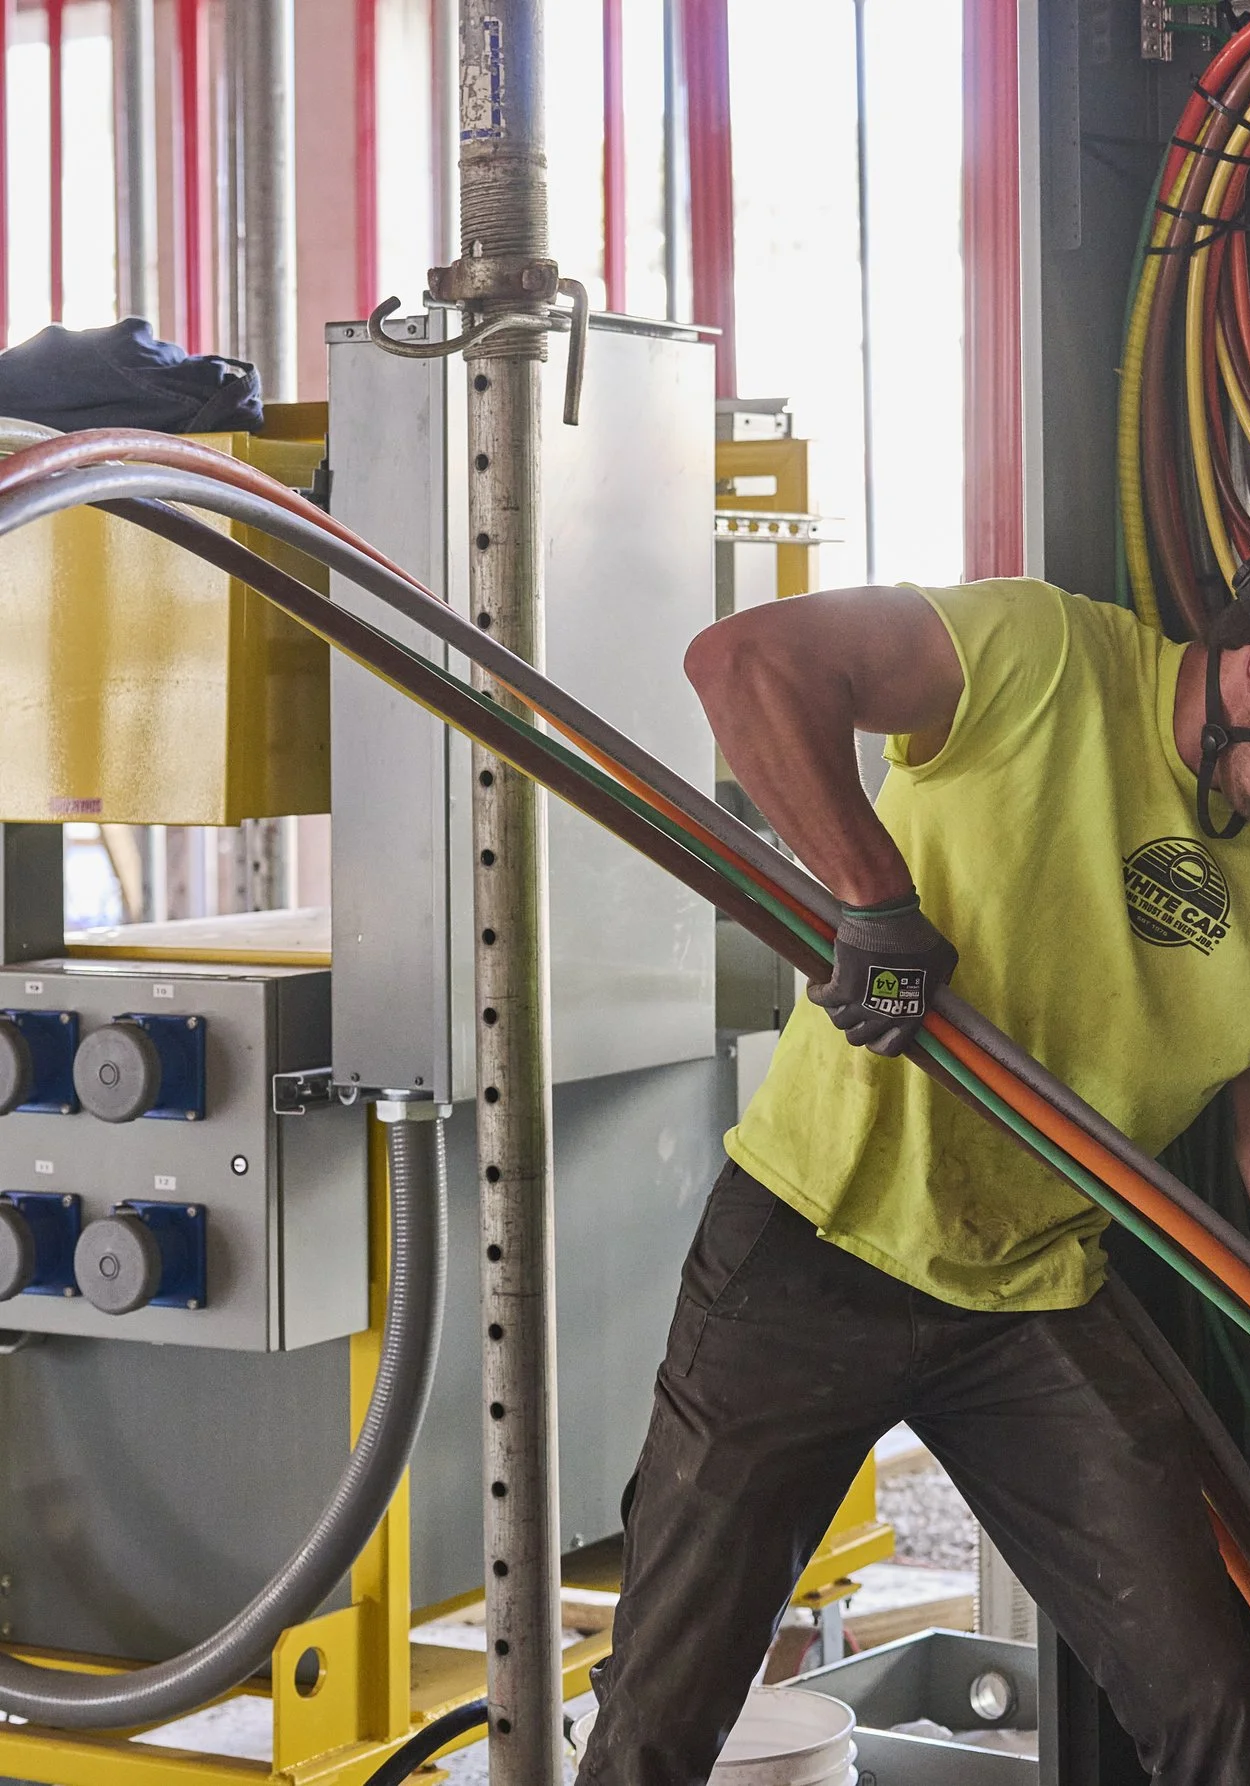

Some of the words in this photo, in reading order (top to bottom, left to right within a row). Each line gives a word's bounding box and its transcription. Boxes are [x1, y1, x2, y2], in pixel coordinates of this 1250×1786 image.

[1138, 898, 1162, 919] TRUST
[1161, 912, 1174, 925] ON
[1173, 920, 1197, 939] EVERY
[876, 978, 897, 990] A4
[158, 1178, 170, 1186] 12
